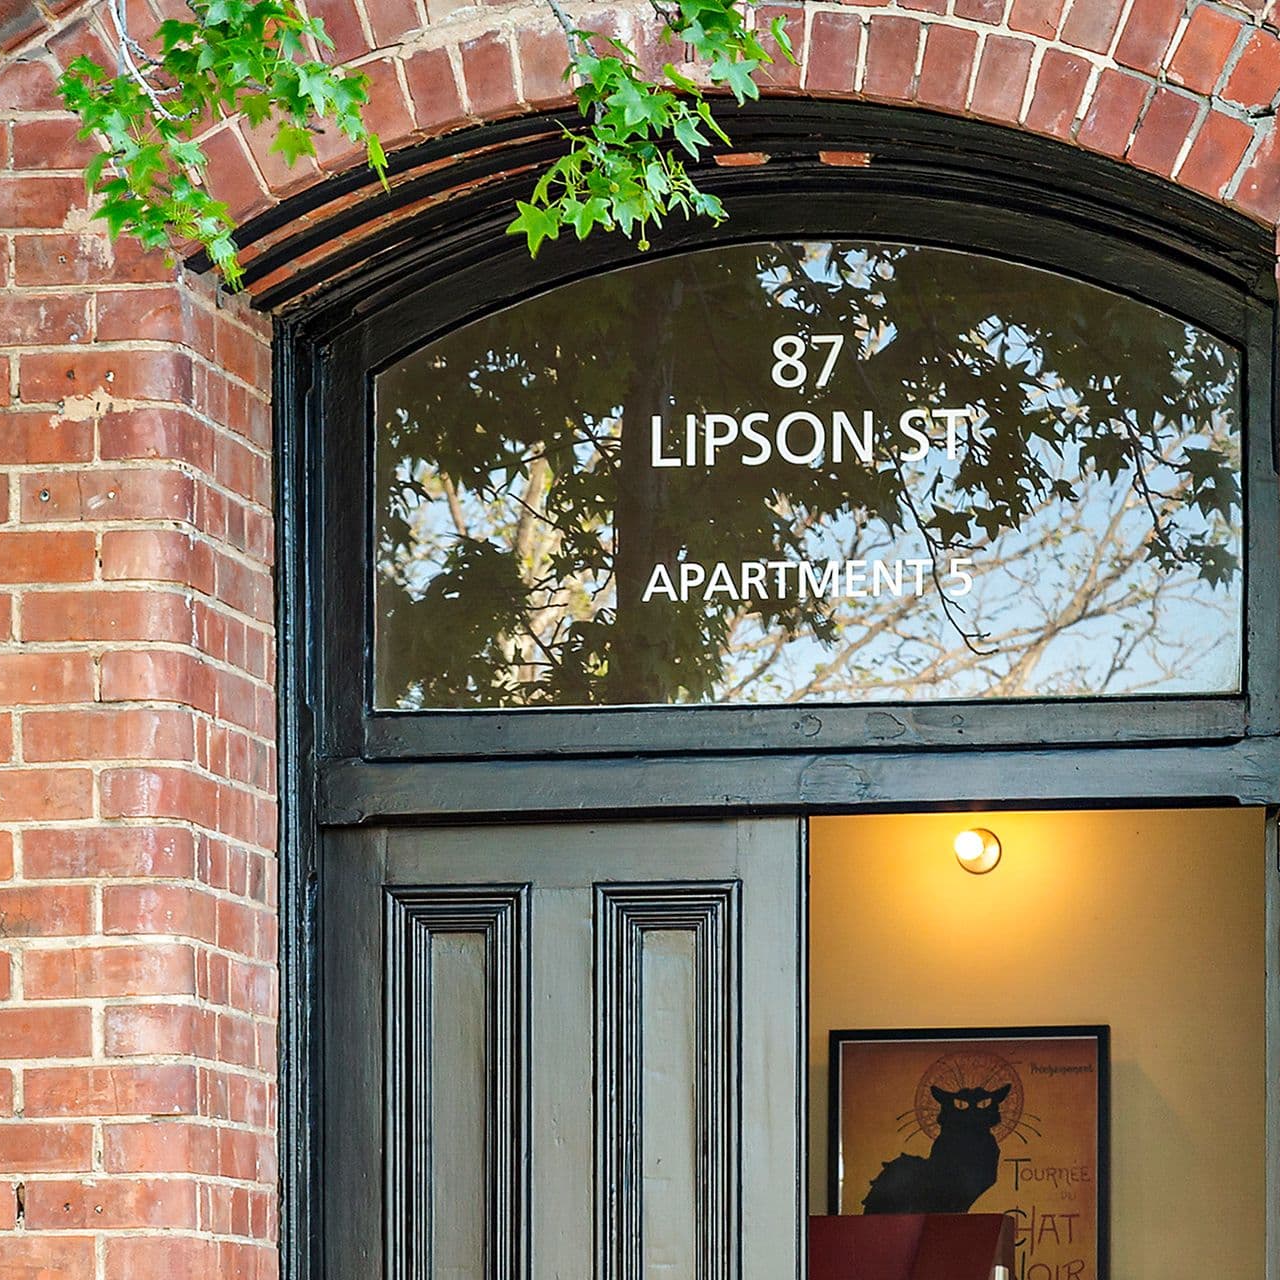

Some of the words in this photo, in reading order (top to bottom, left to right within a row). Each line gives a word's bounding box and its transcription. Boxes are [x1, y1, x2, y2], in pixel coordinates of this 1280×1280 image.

[770, 334, 844, 390] 87
[650, 409, 874, 468] LIPSON
[899, 407, 974, 462] ST
[642, 558, 934, 602] APARTMENT
[949, 557, 973, 597] 5
